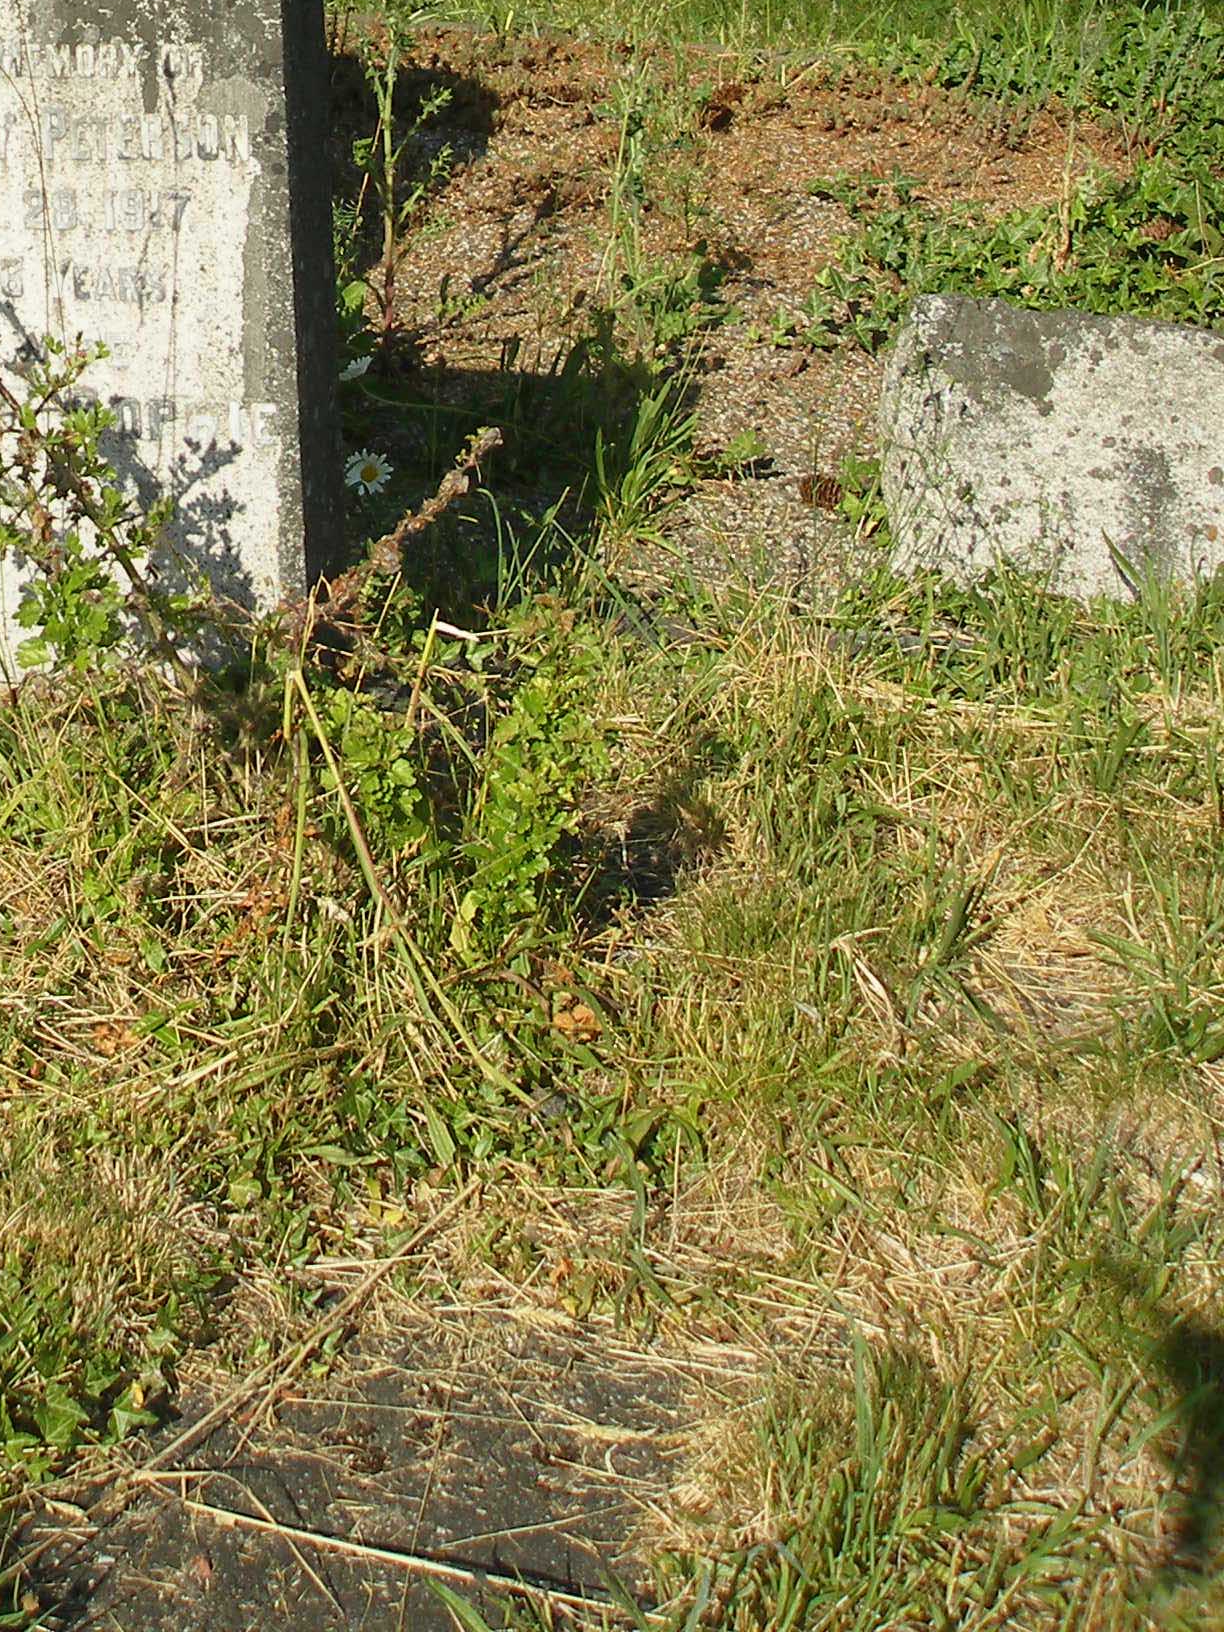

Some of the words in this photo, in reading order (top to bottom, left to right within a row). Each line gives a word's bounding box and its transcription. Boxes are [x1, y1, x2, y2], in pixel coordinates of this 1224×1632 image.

[160, 39, 205, 76] OF
[41, 103, 250, 161] PETERSON
[43, 256, 168, 302] YEARS
